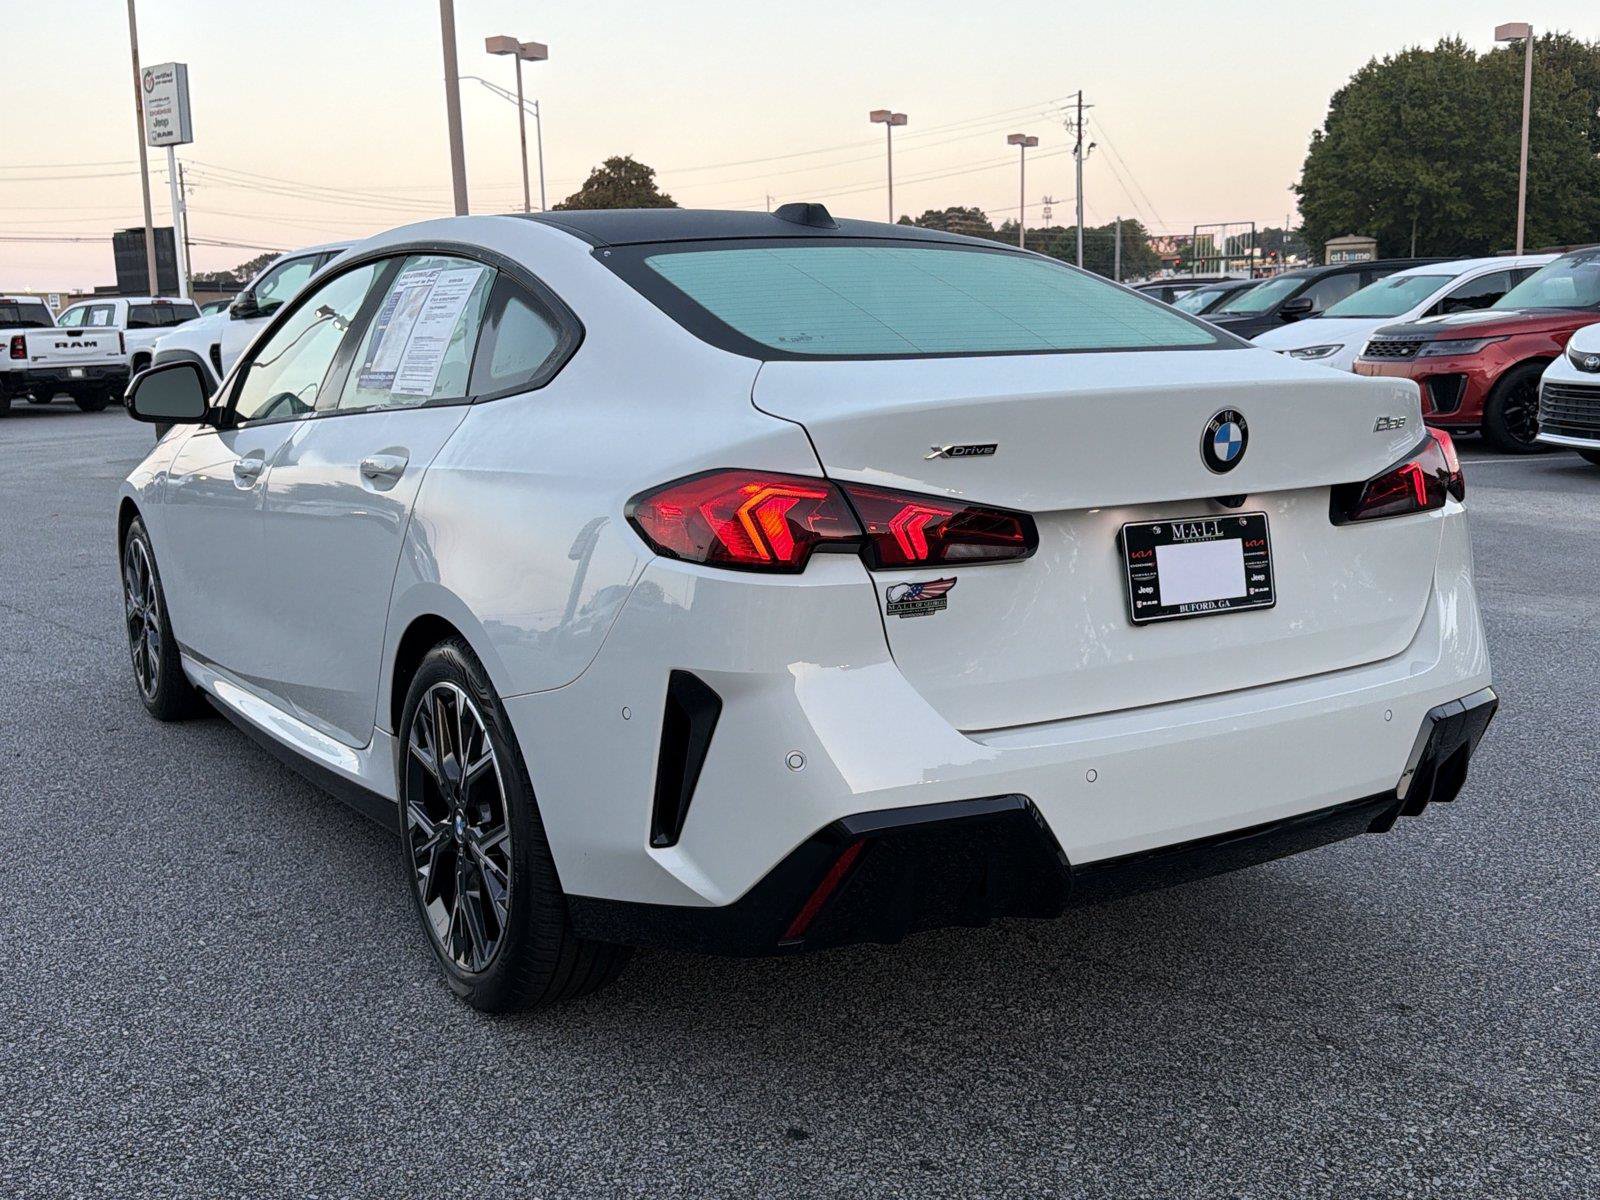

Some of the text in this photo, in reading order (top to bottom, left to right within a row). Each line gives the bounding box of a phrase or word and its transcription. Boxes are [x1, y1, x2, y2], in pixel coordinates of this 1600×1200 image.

[153, 117, 169, 128] Jeep
[1331, 251, 1371, 261] at home
[55, 341, 98, 349] RAM
[1250, 574, 1266, 582] Jeep
[1138, 586, 1154, 595] Jeep
[1218, 600, 1231, 608] GA
